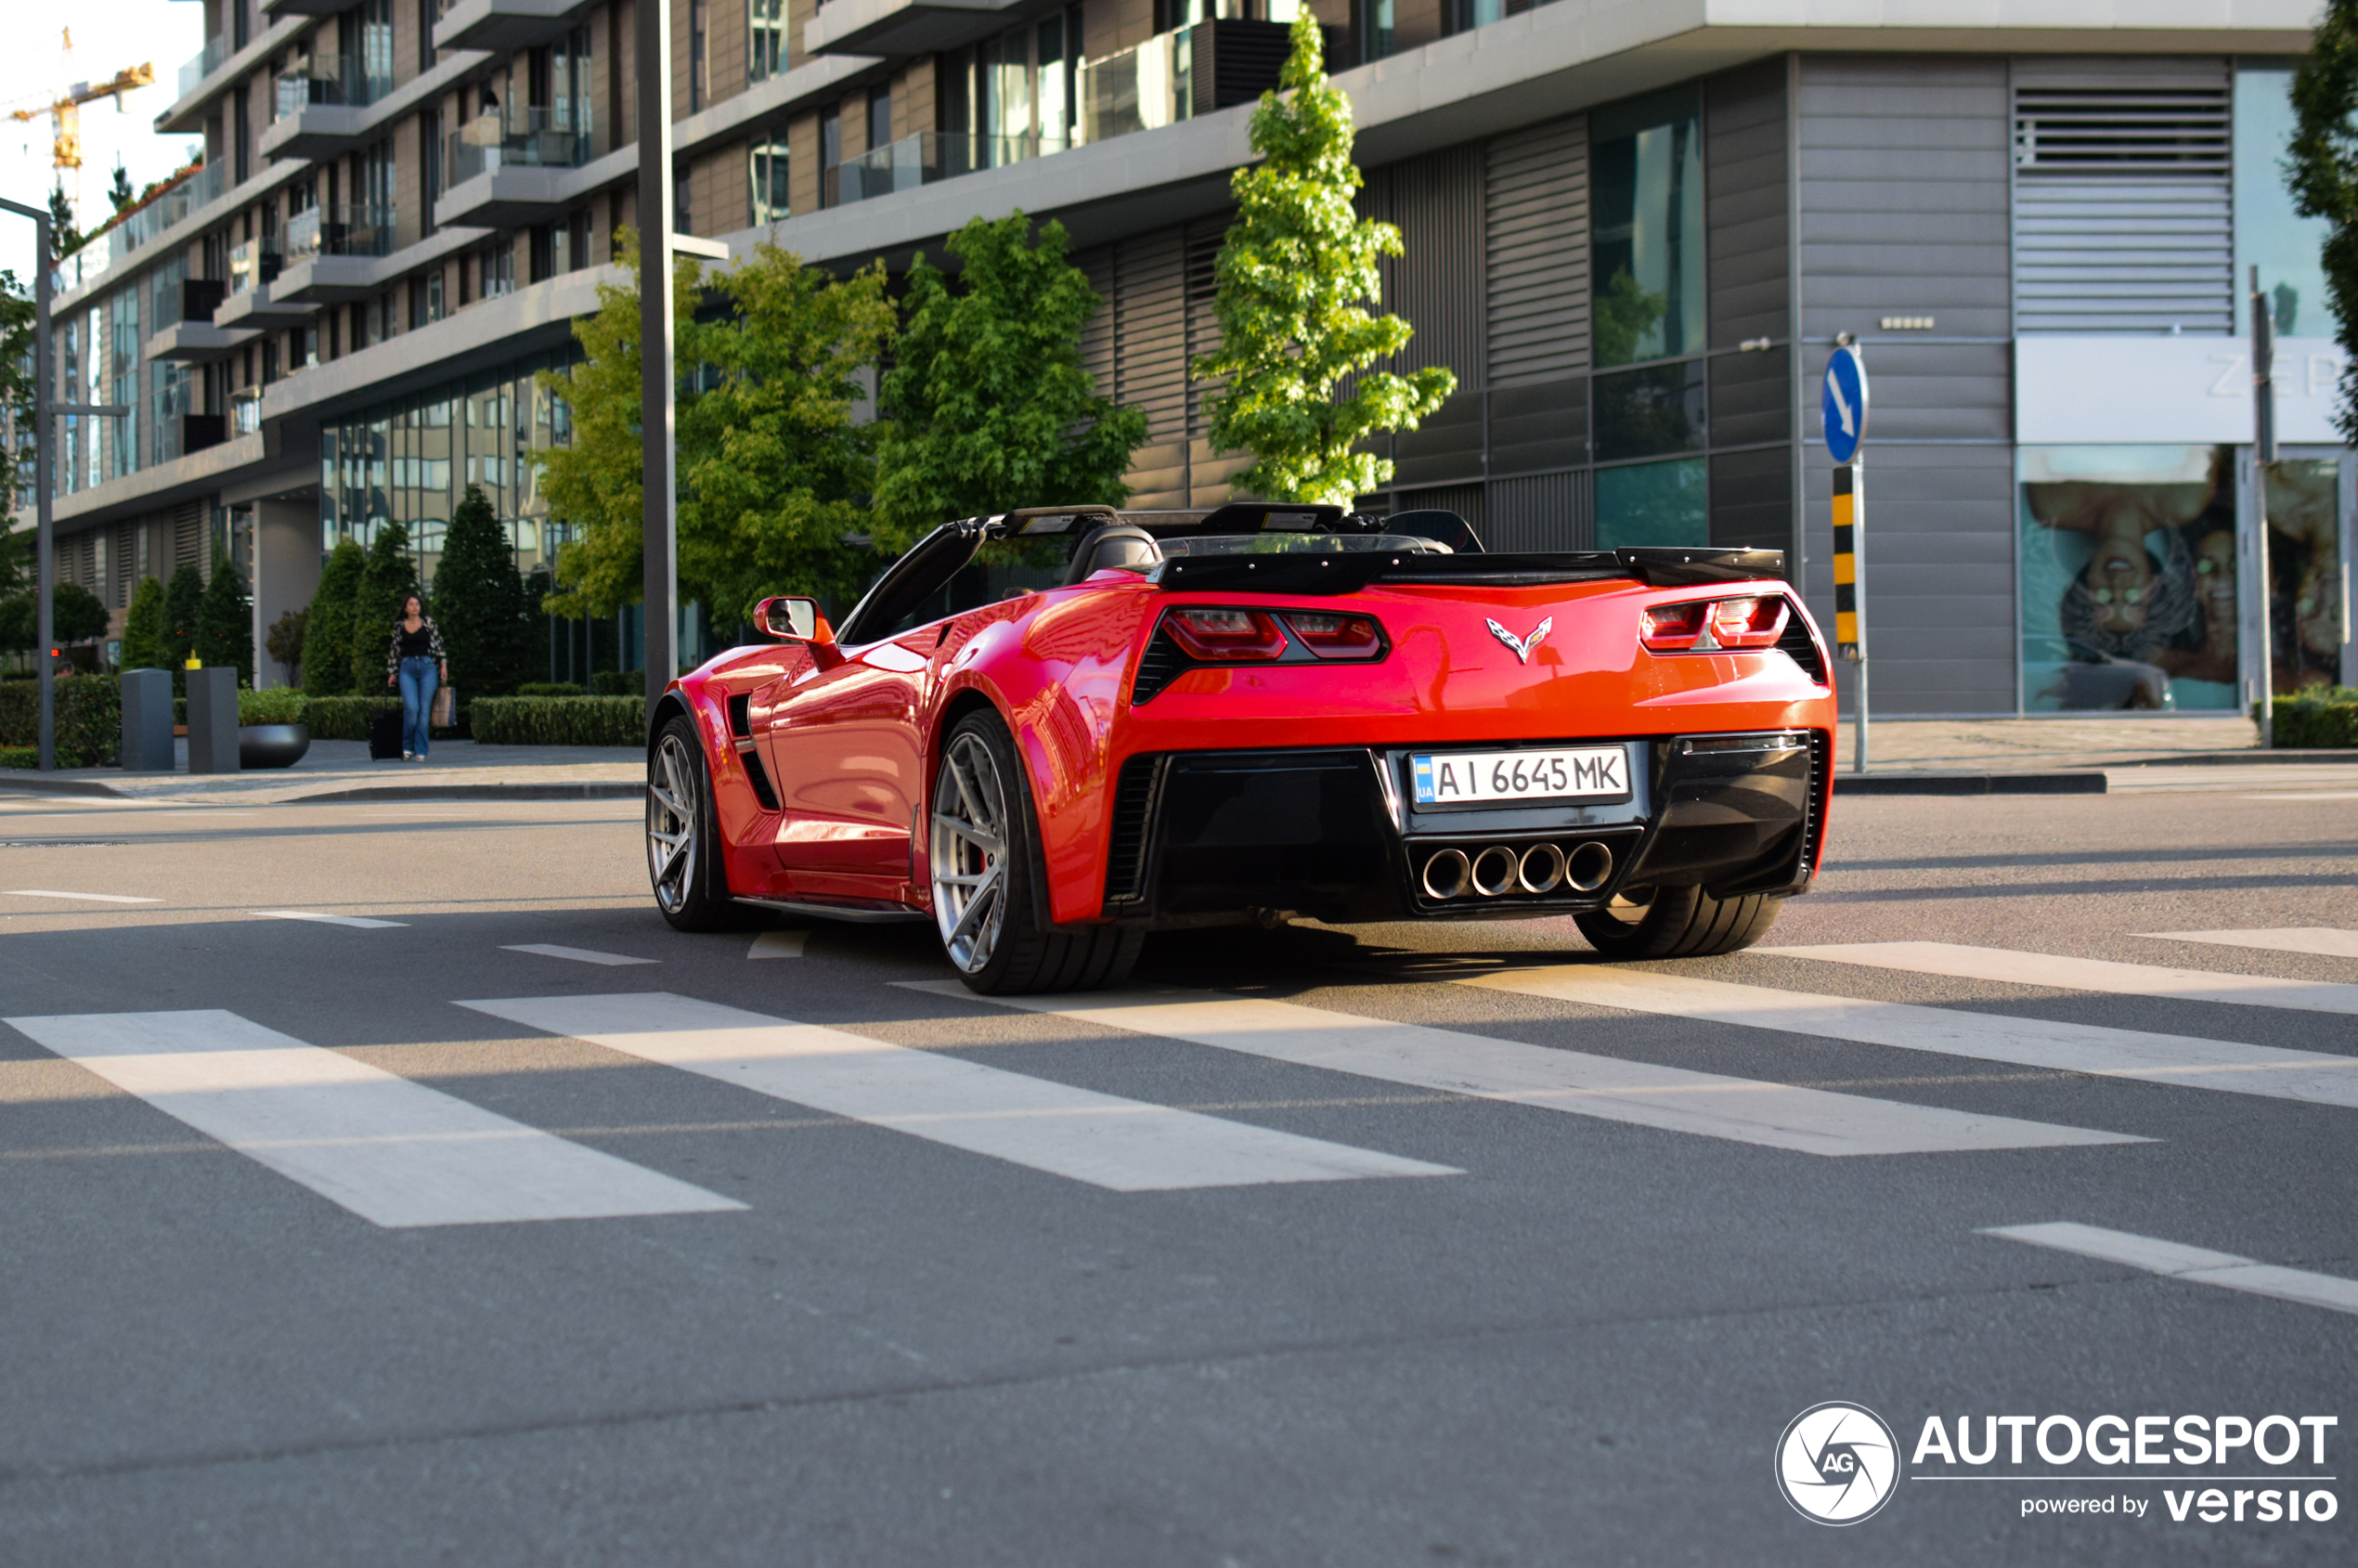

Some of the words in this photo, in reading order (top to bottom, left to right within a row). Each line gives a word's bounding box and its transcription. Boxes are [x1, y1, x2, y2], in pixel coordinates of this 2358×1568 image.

[1492, 758, 1567, 793] 6645
[1574, 755, 1621, 789] MK
[1418, 786, 1433, 798] UA
